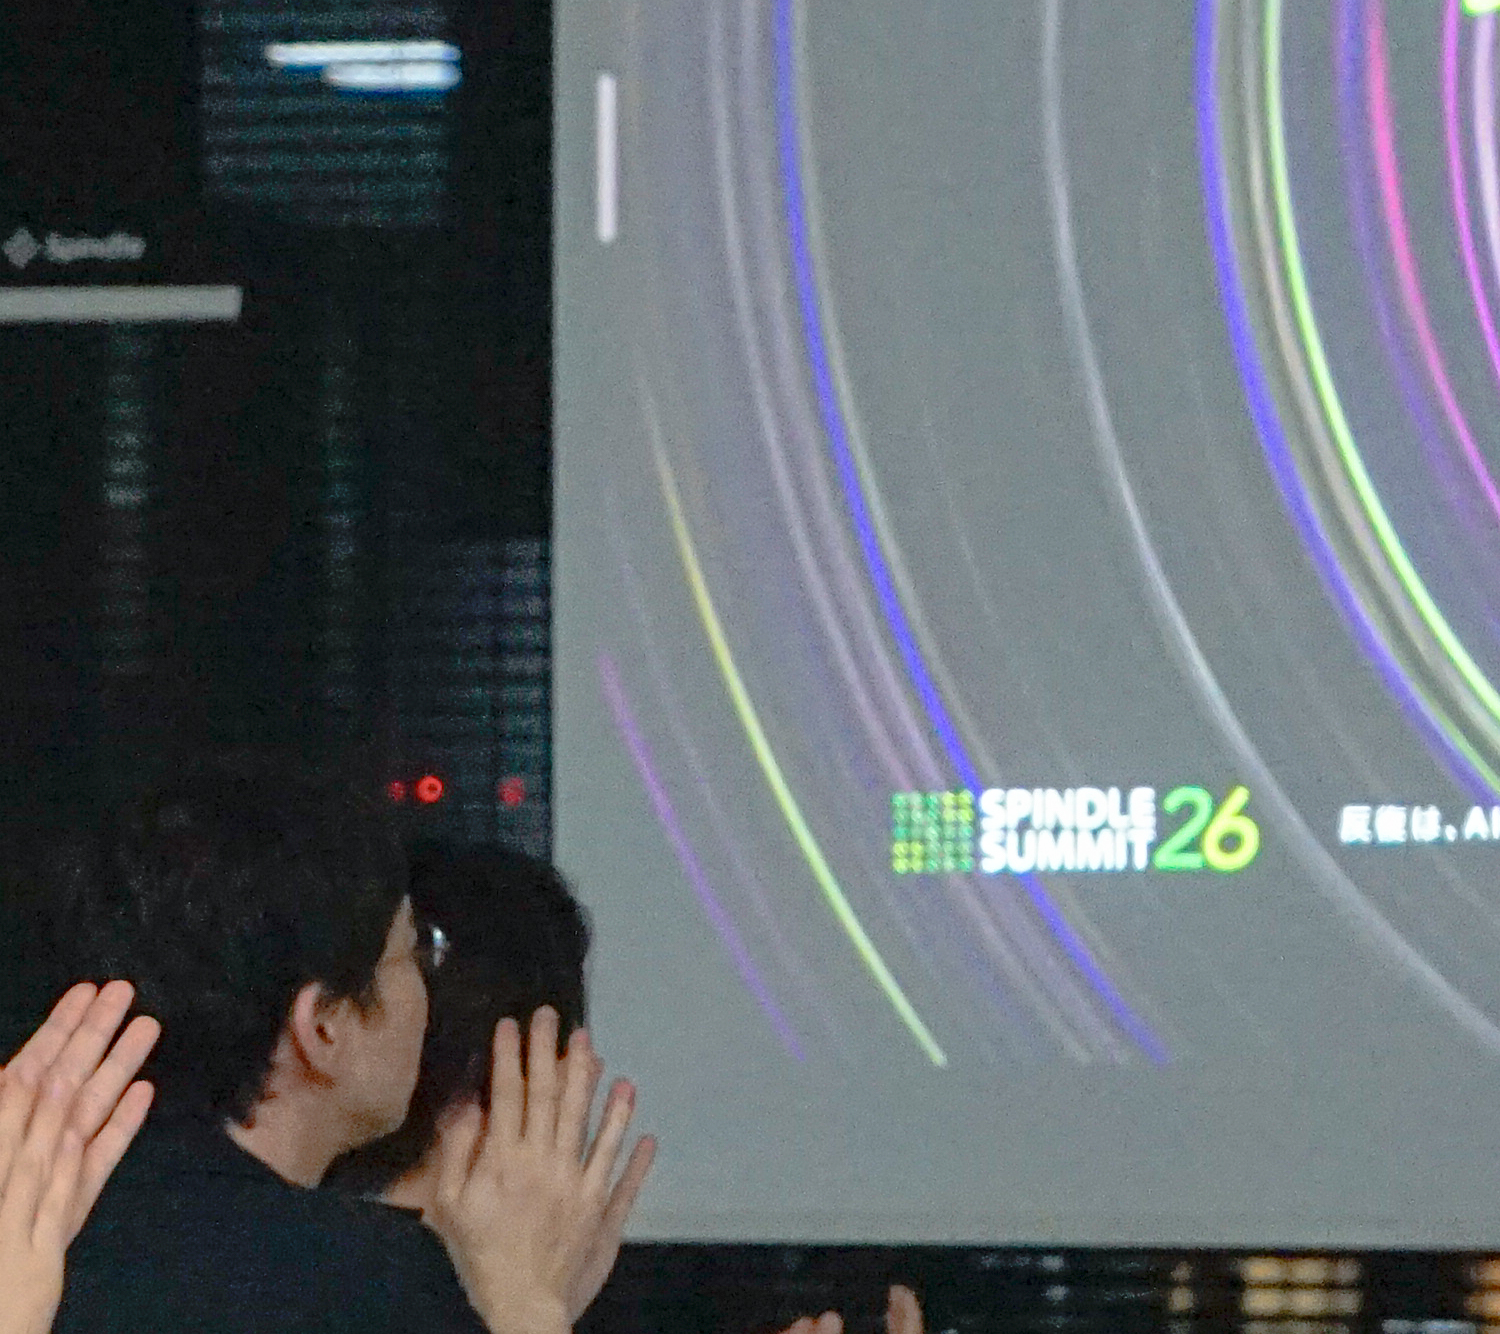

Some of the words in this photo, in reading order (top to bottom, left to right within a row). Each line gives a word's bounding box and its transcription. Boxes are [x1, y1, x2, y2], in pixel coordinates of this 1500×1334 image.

[979, 786, 1155, 830] SPINDLE
[1153, 784, 1260, 871] 26
[979, 827, 1156, 873] SUMMIT
